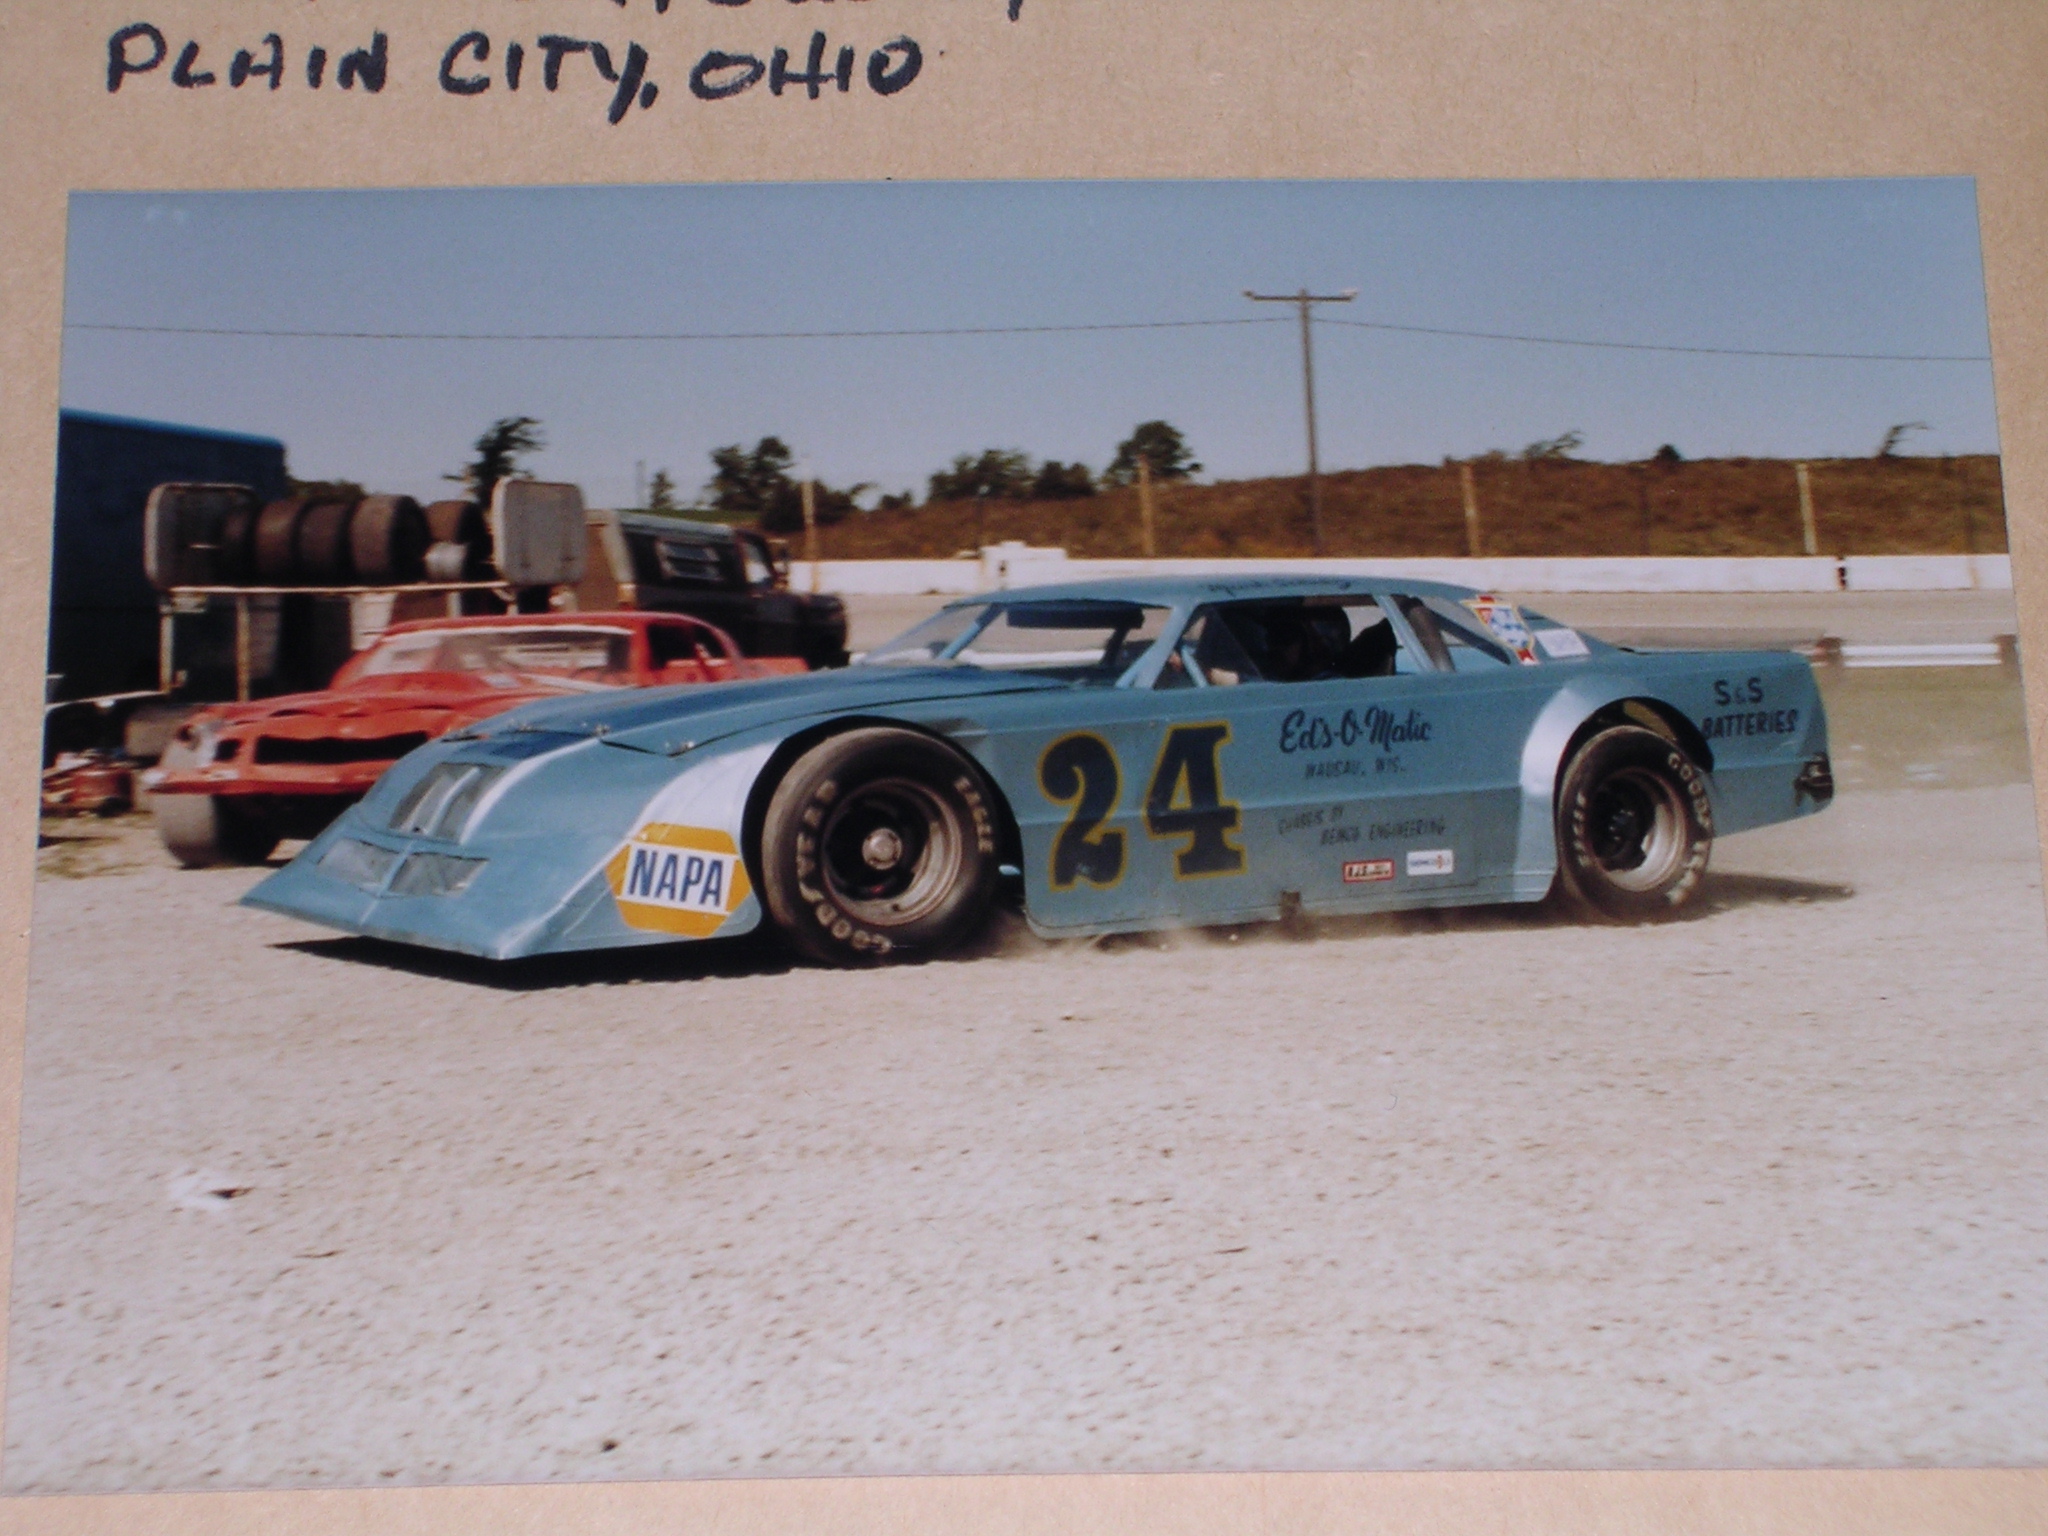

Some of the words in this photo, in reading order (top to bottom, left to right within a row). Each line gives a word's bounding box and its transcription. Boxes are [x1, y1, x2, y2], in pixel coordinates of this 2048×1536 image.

[107, 22, 389, 93] PLAIN
[438, 31, 658, 126] CITY,
[688, 30, 924, 100] OHIO
[1701, 709, 1799, 739] BATTERIES
[1038, 720, 1248, 893] 24
[628, 848, 725, 908] NAPA
